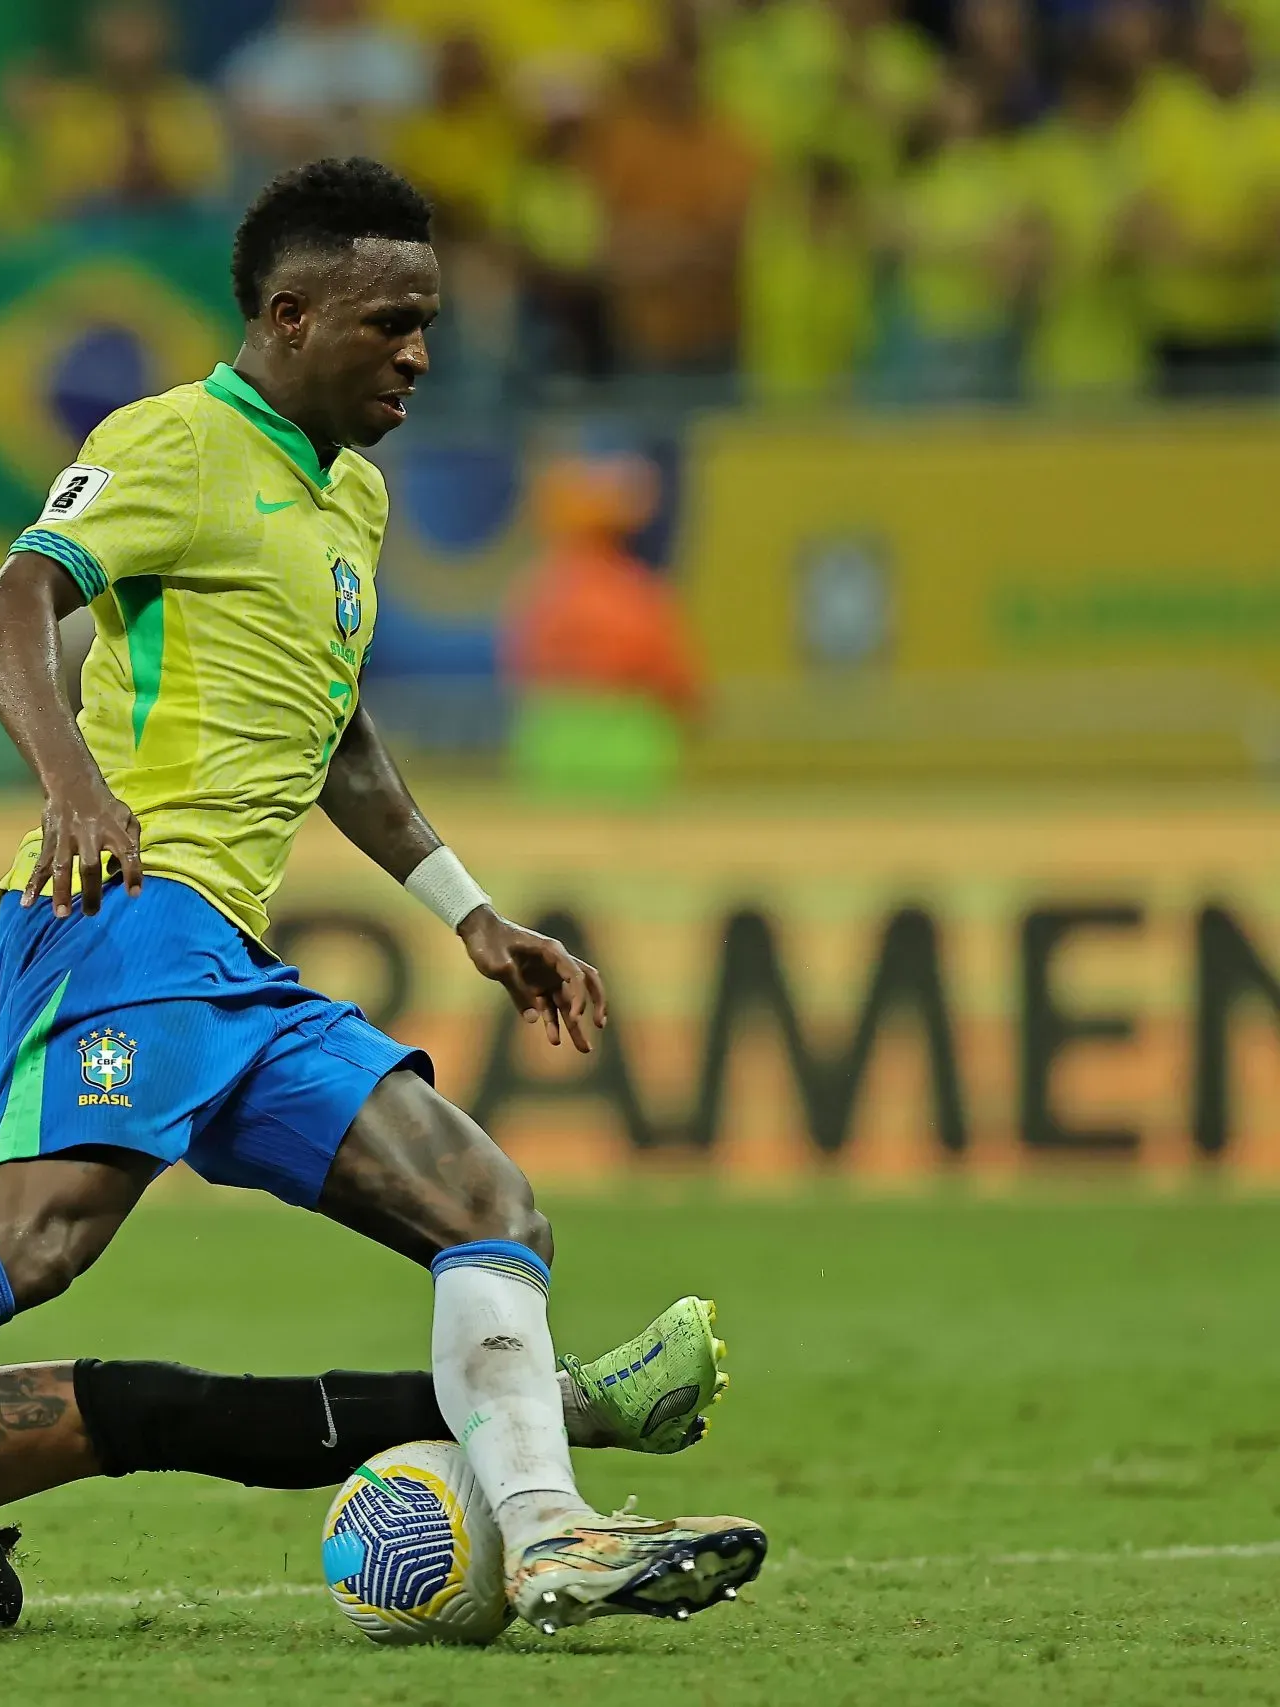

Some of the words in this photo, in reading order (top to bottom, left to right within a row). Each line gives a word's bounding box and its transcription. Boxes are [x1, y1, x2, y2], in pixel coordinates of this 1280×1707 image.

[329, 640, 356, 667] BRASIL
[96, 1058, 117, 1066] CBF
[78, 1093, 133, 1108] BRASIL
